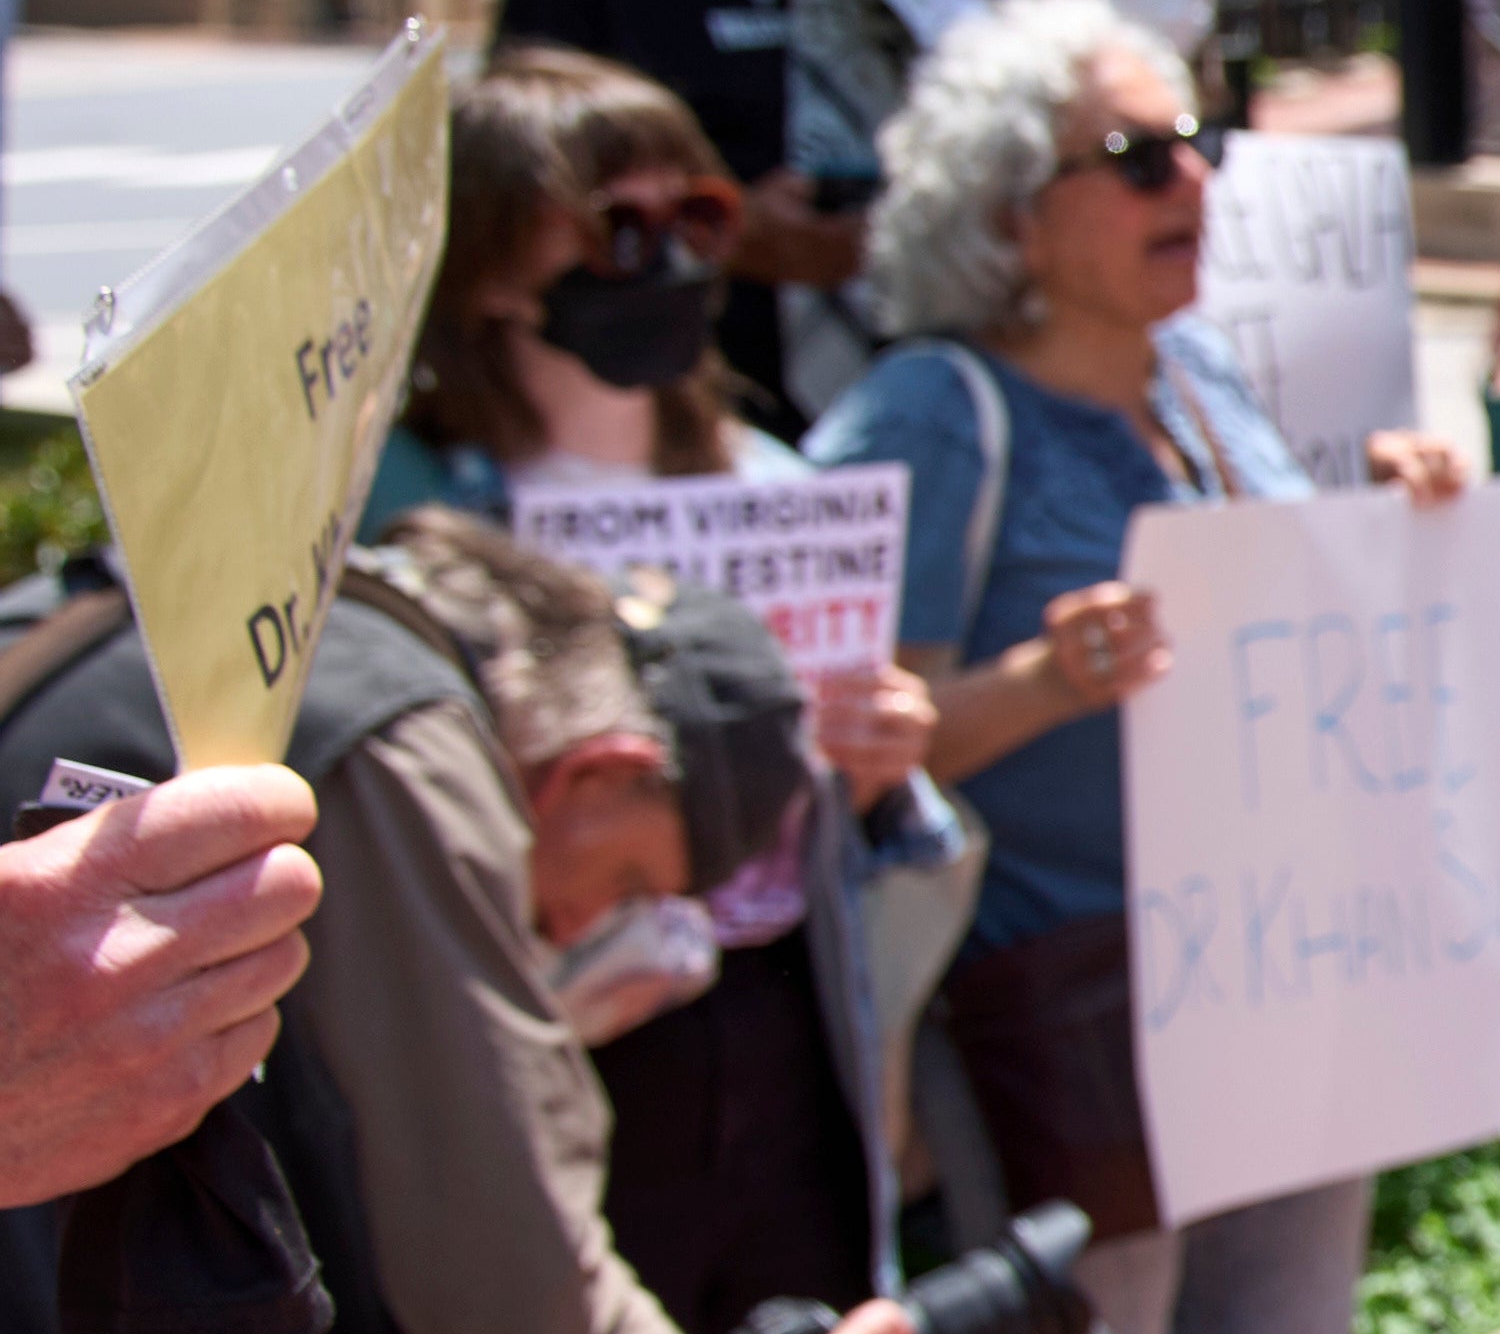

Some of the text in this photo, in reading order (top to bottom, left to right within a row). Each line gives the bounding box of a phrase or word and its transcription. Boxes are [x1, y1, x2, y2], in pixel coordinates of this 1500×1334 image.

[296, 298, 372, 420] Free
[531, 499, 672, 549] FROM
[247, 592, 312, 689] Dr.
[1228, 602, 1477, 812] FREE
